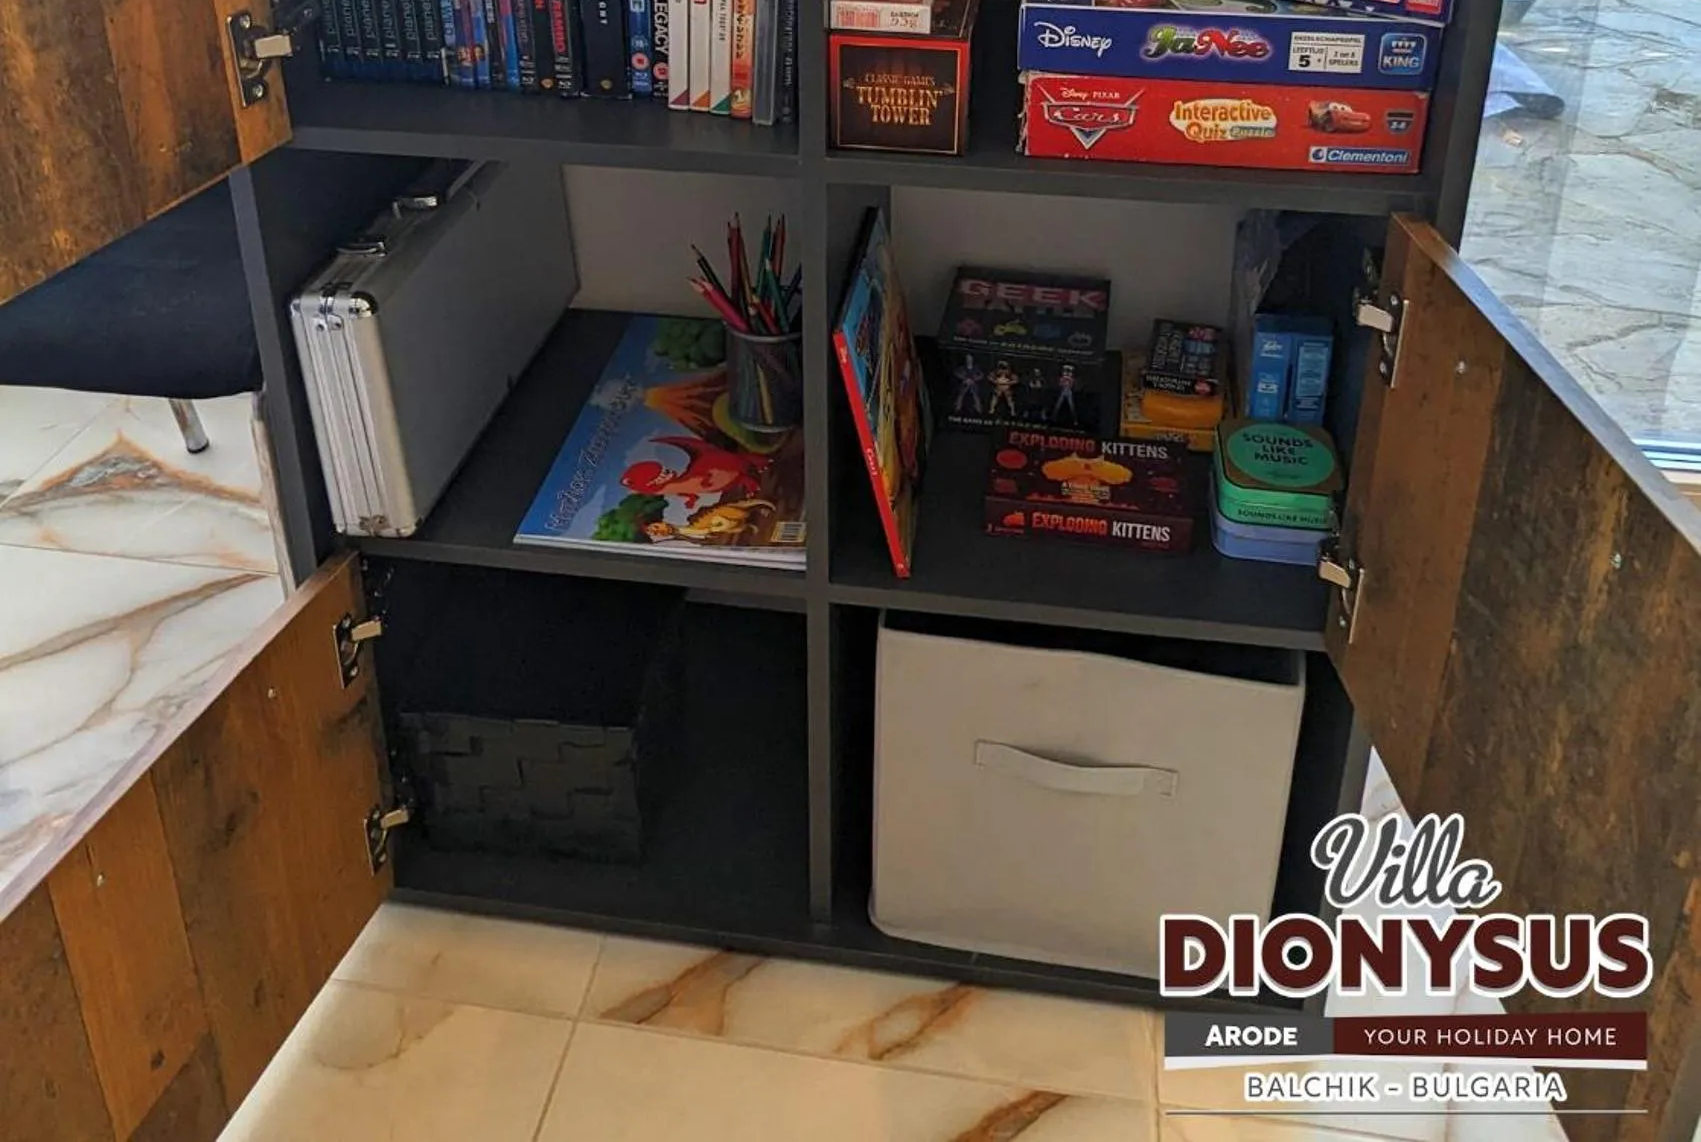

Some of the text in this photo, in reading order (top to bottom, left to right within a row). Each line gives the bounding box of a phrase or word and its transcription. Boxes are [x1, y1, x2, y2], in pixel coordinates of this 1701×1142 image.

[1298, 55, 1311, 68] 5
[1383, 55, 1420, 68] KING
[871, 104, 932, 126] TOWER
[1174, 101, 1271, 121] Interactive
[1185, 121, 1227, 141] Quiz
[1327, 148, 1409, 165] Clementoni
[960, 280, 1106, 309] GEEK
[1009, 430, 1096, 453] EXPLODING
[1101, 440, 1168, 460] KITTENS
[1242, 432, 1314, 449] SOUNDS
[1254, 452, 1309, 466] MUSIC
[1261, 444, 1297, 456] LIKE
[1031, 511, 1171, 543] EXPLODING KITTENS
